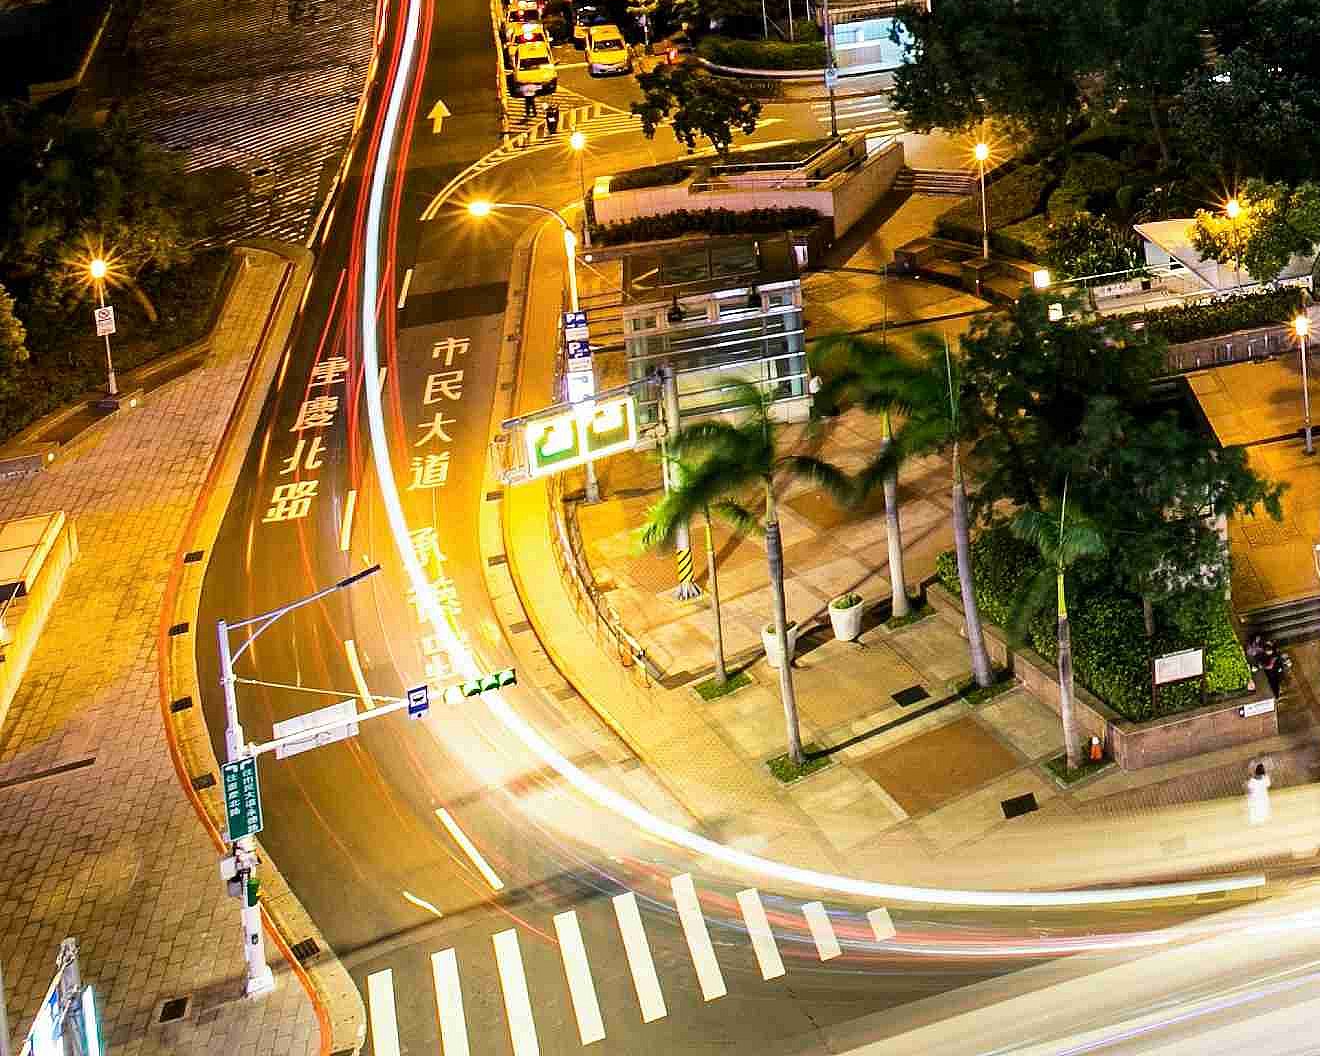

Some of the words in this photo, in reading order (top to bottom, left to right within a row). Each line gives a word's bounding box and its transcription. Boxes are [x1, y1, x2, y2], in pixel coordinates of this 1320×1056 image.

[261, 356, 350, 524] 重慶北路
[405, 336, 471, 491] 市民大道
